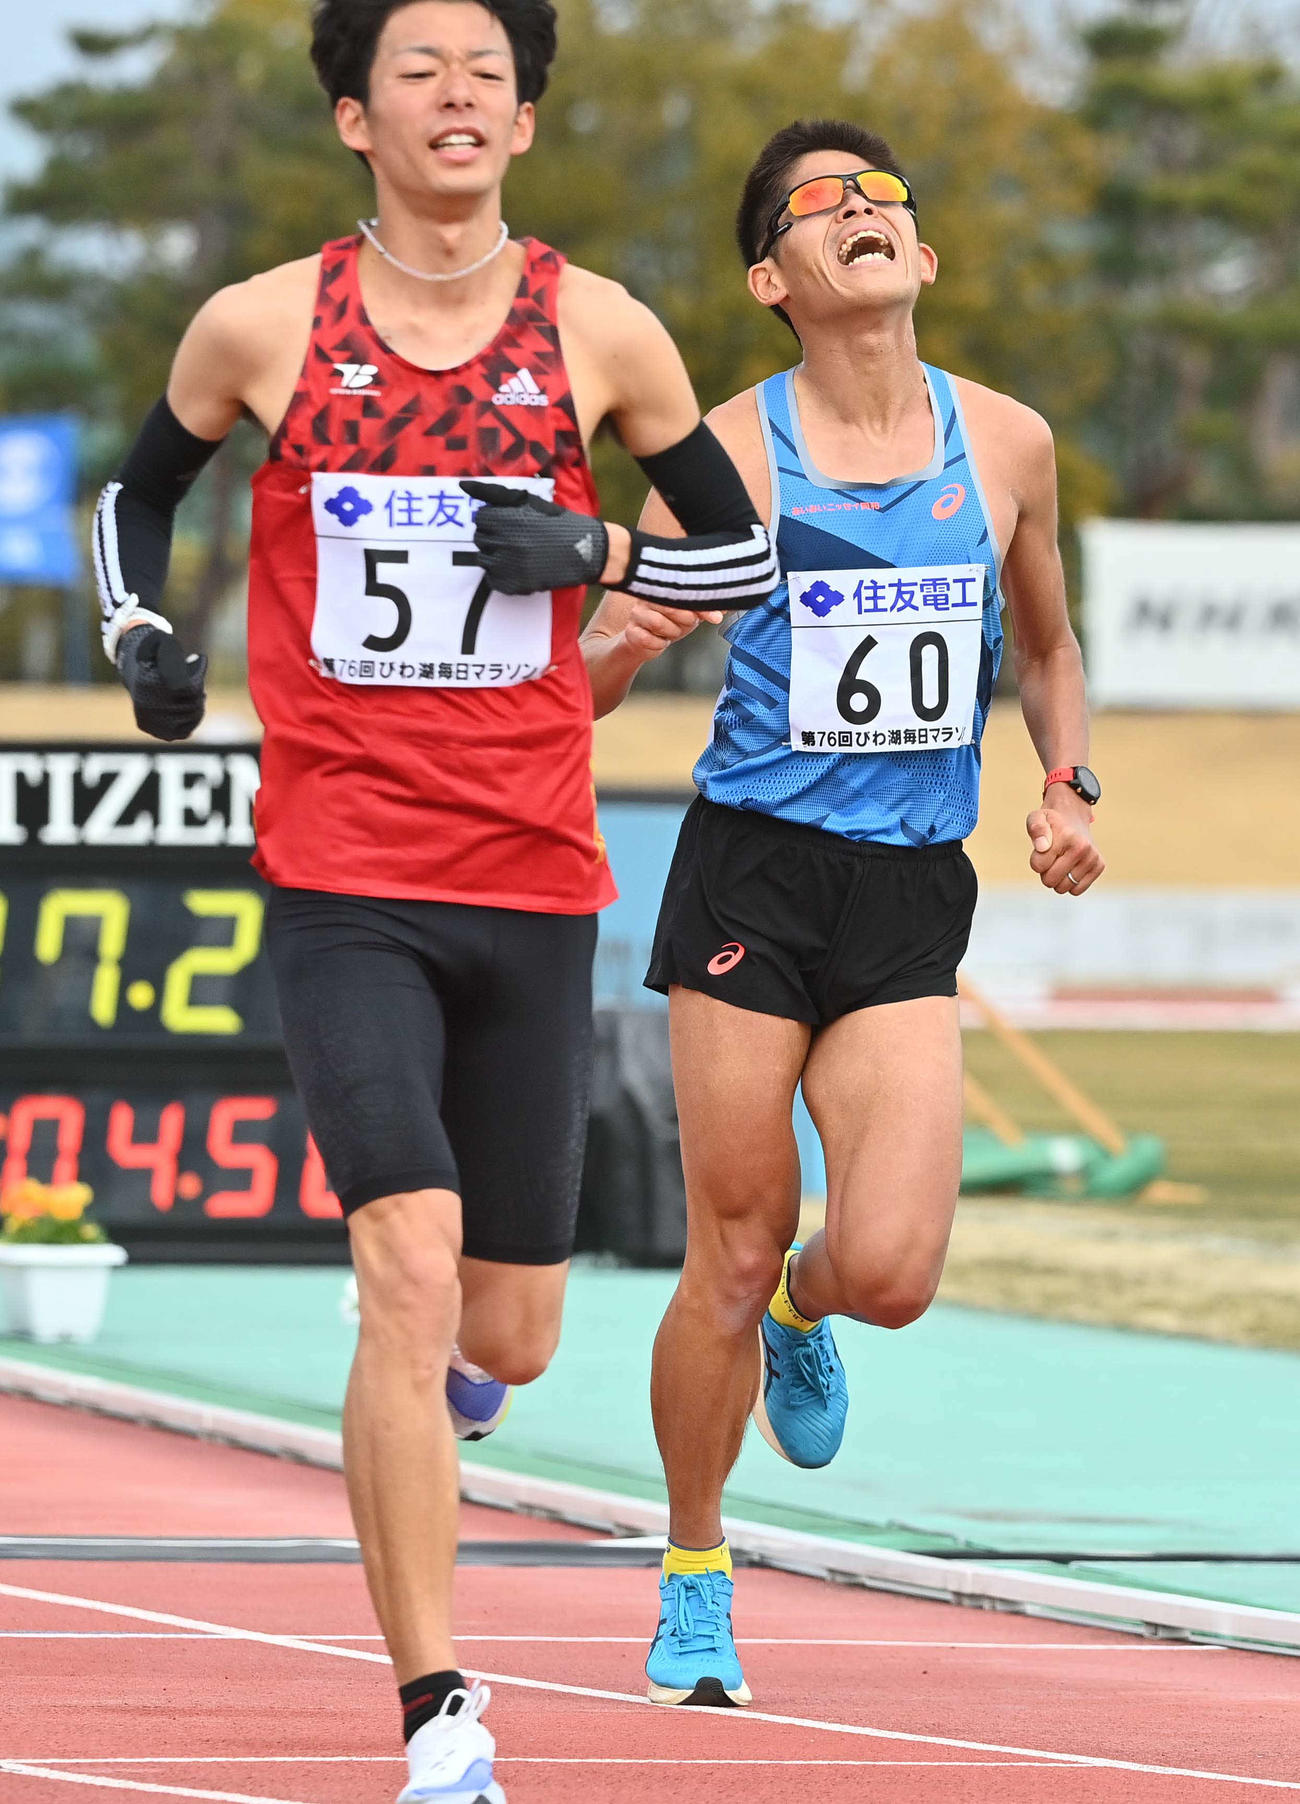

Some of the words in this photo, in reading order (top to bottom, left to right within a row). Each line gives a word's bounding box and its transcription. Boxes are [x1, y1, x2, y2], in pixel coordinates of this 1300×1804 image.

[492, 393, 549, 406] adidas
[384, 490, 483, 527] 住友
[361, 548, 492, 654] 57
[853, 577, 978, 614] 住友電工
[836, 631, 949, 725] 60
[801, 726, 967, 747] 第76回びわ湖毎日マラソ
[0, 889, 265, 1033] 7.2
